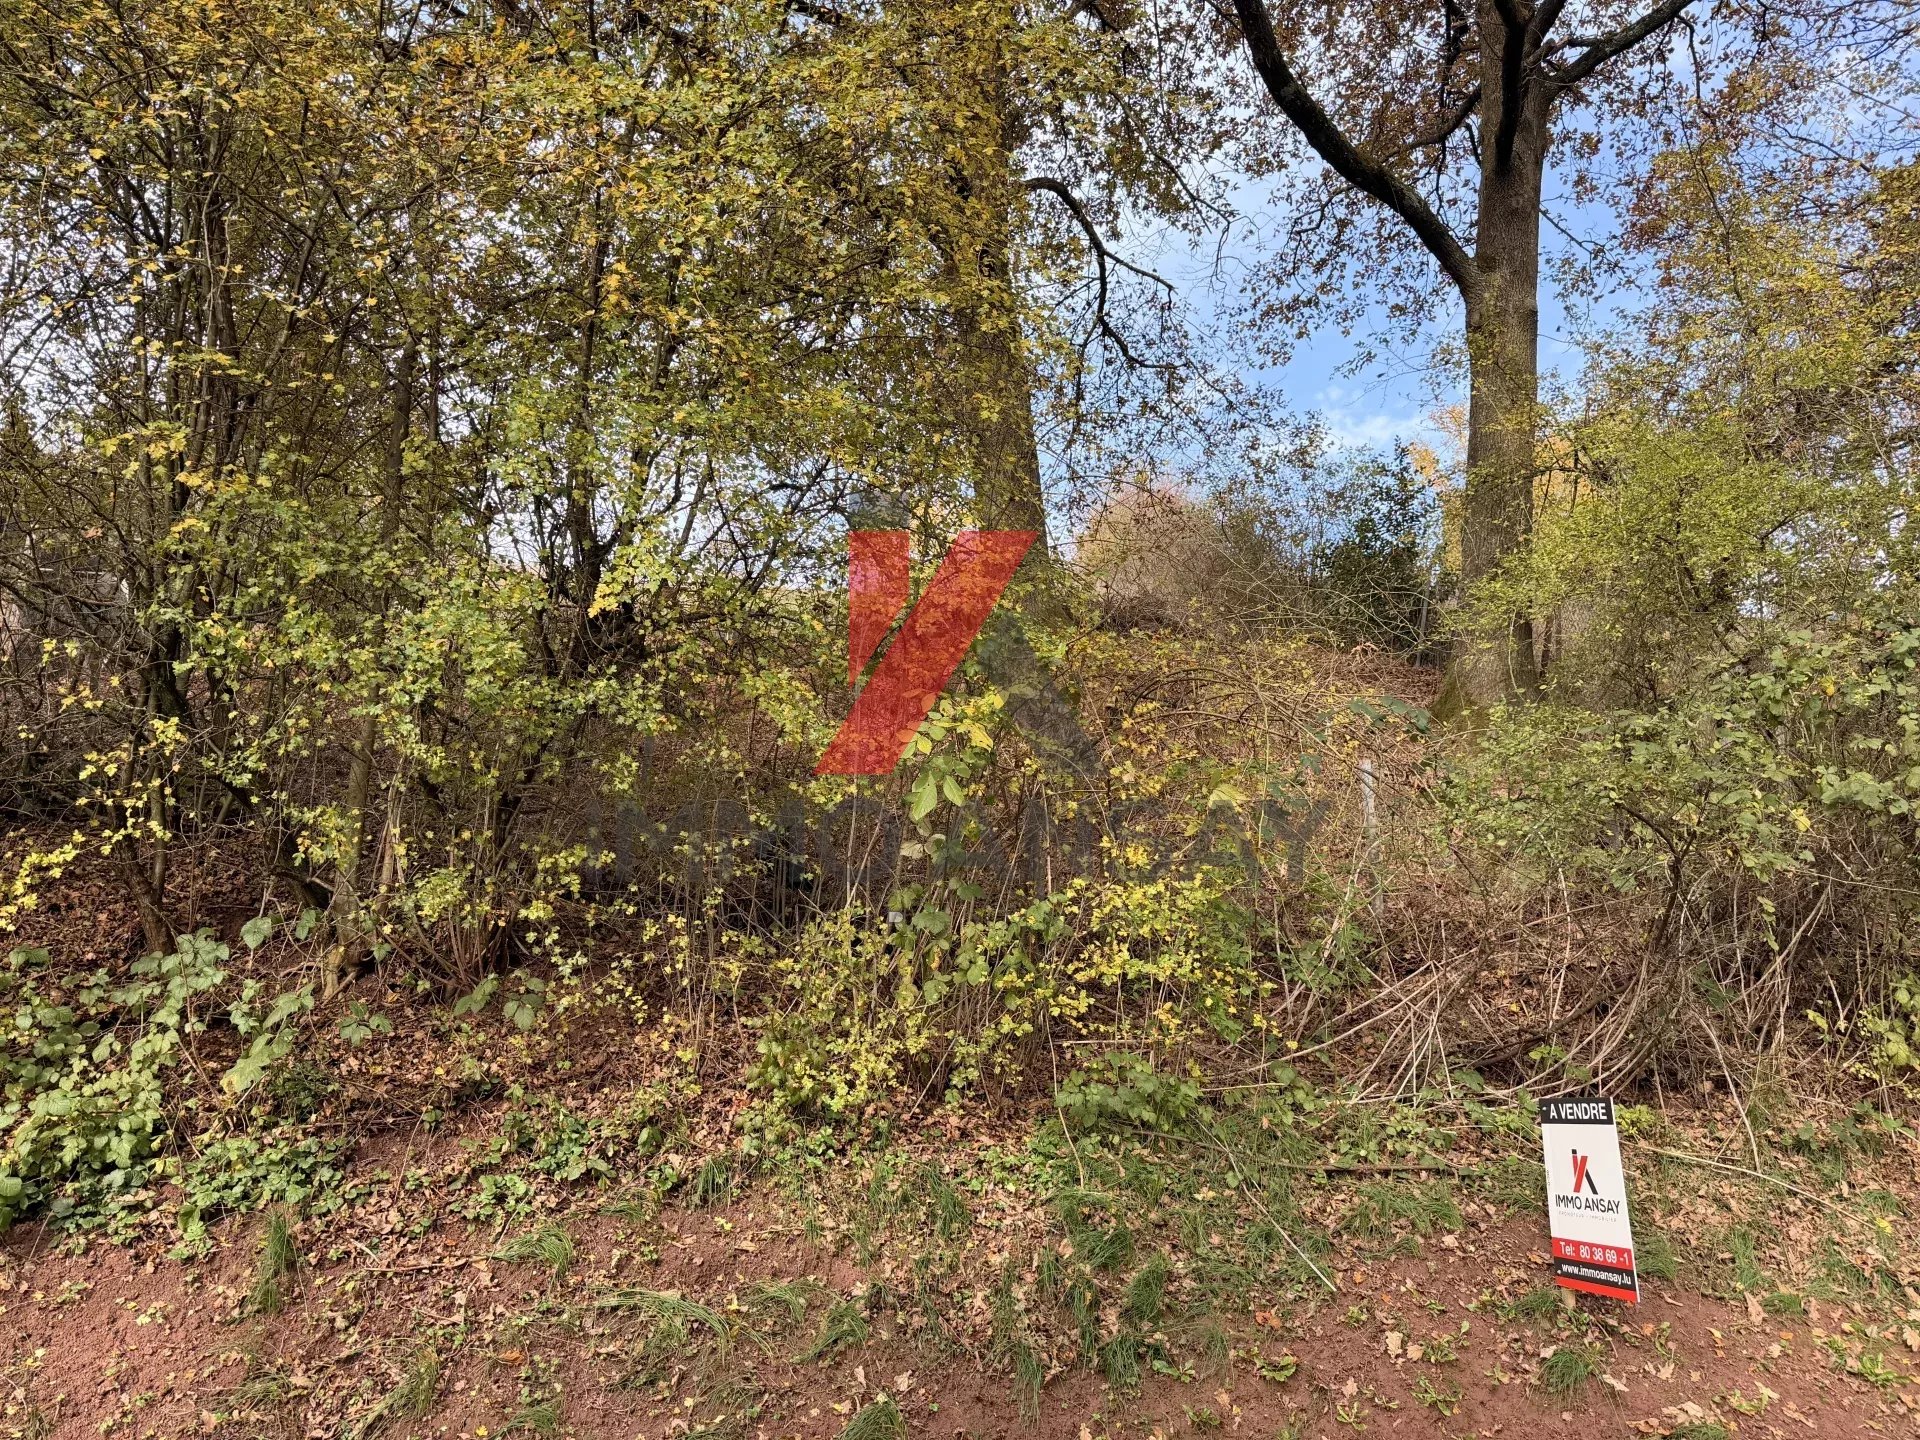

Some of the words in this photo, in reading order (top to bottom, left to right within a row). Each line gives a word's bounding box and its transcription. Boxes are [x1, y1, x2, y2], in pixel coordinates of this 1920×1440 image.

[1549, 1103, 1558, 1120] A
[1558, 1102, 1608, 1120] VENDRE
[1555, 1194, 1583, 1210] IMMO
[1584, 1198, 1620, 1215] ANSAY
[1560, 1241, 1576, 1256] Tel:
[1579, 1244, 1591, 1259] 80
[1592, 1247, 1604, 1262] 38
[1605, 1249, 1617, 1264] 69
[1561, 1263, 1632, 1285] www.immoansay.lu
